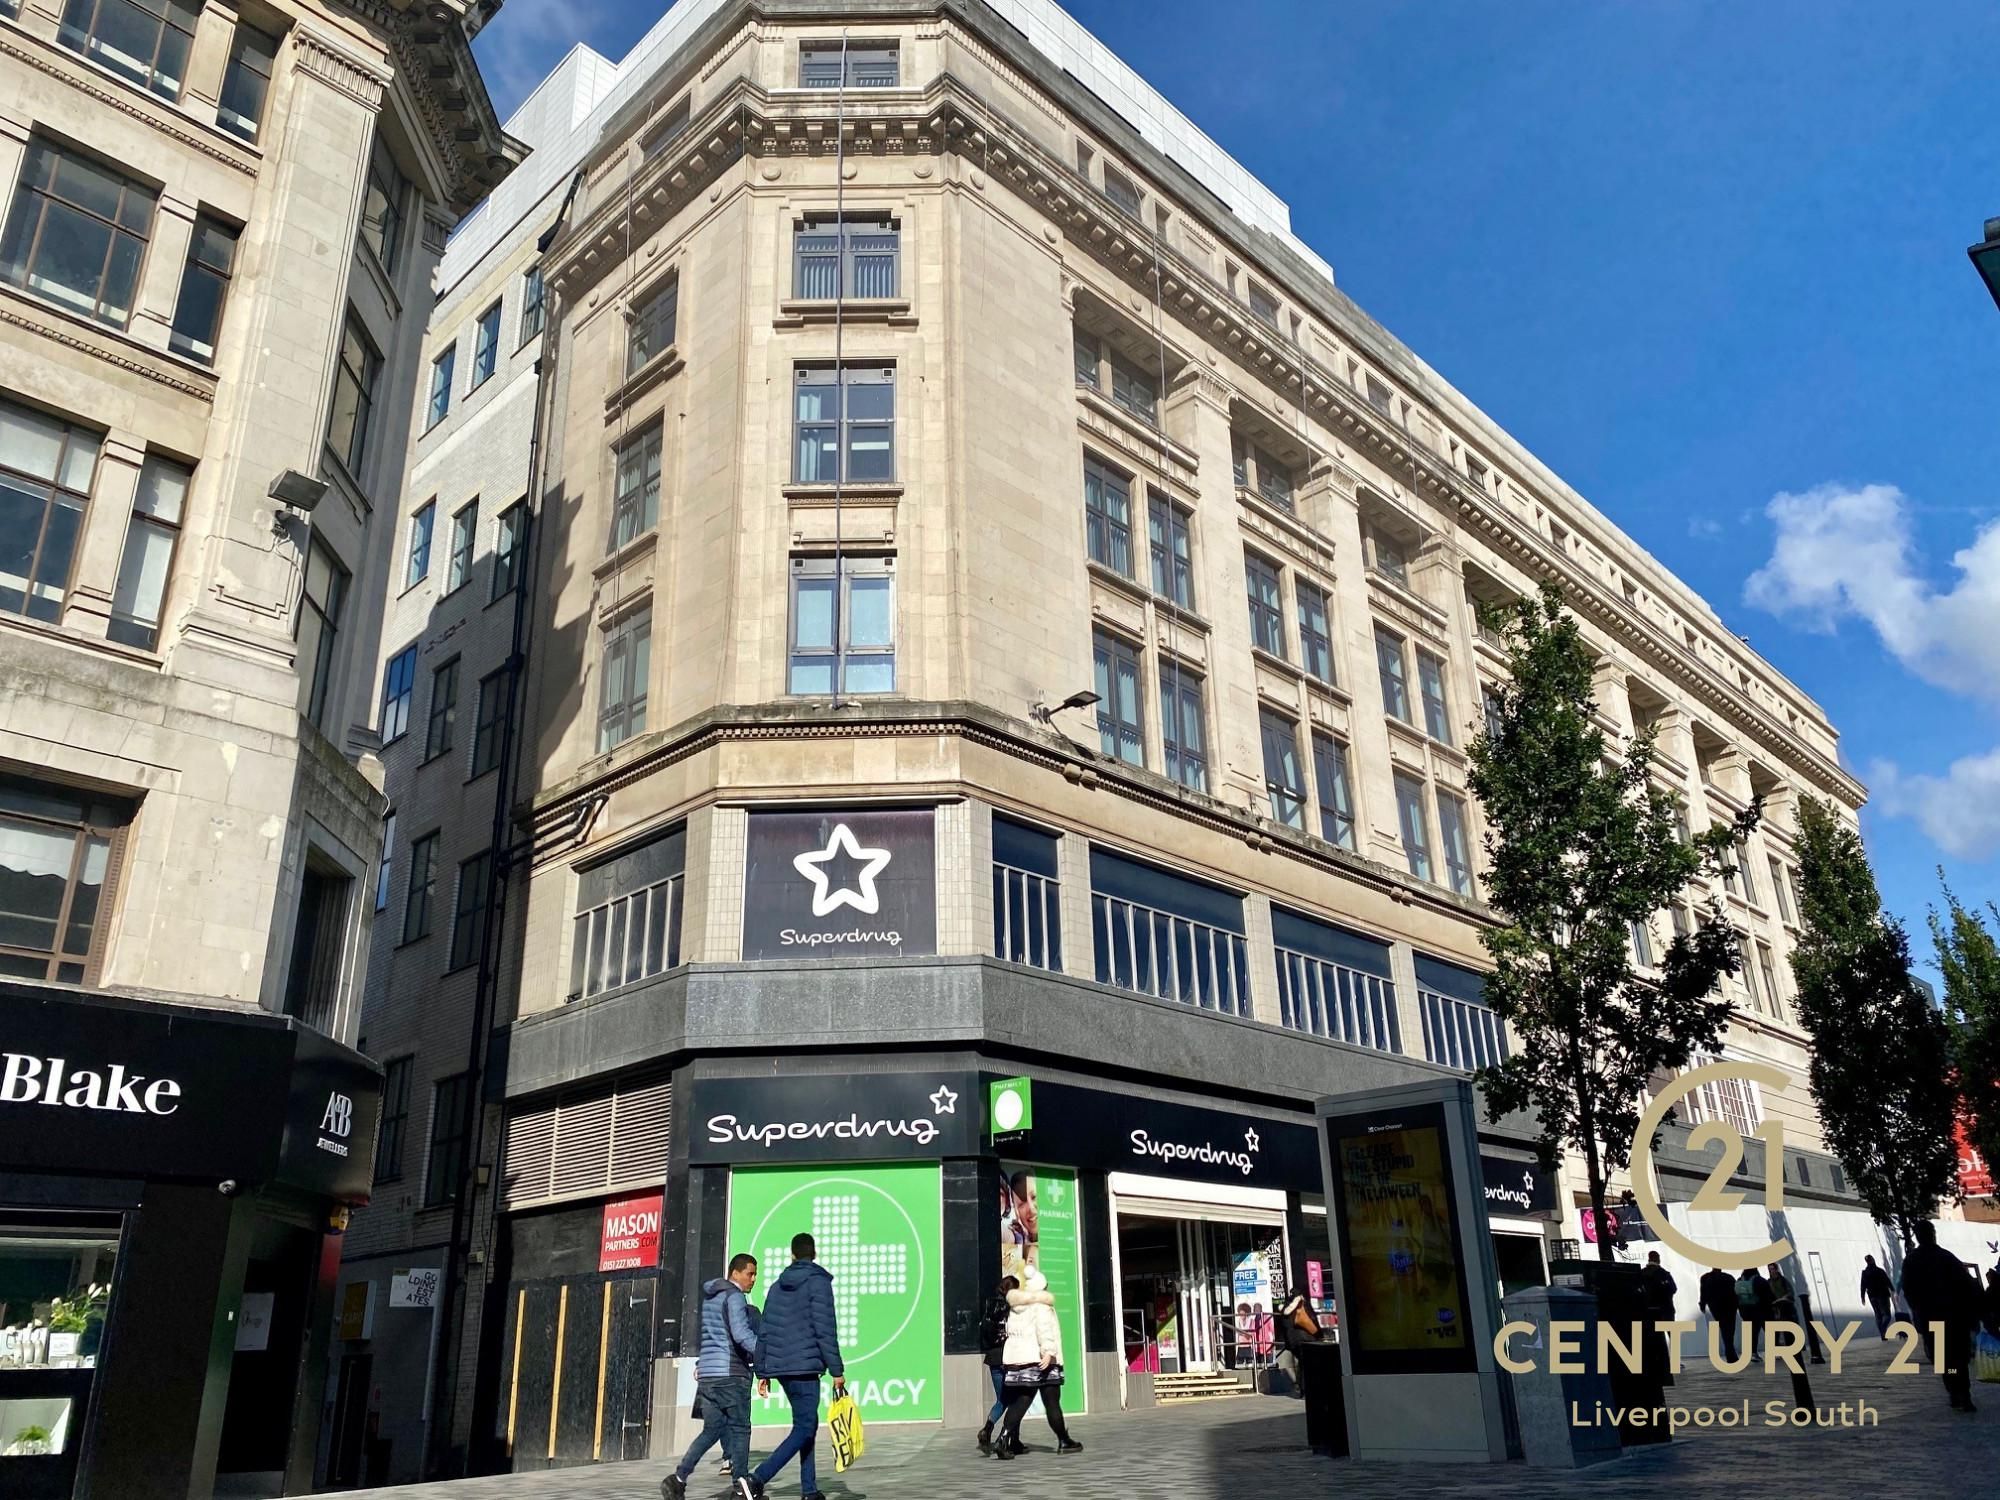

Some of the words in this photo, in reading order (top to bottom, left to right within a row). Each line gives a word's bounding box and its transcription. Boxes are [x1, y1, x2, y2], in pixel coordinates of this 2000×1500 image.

[779, 927, 903, 947] Superdrug
[0, 1053, 182, 1115] Blake
[707, 1113, 940, 1147] Superdrug
[1130, 1129, 1254, 1176] Superdrug
[1484, 1184, 1532, 1209] erdrug
[1039, 1209, 1073, 1220] PHARMACY
[606, 1211, 658, 1238] MASON
[603, 1261, 615, 1270] 0151
[615, 1259, 626, 1269] 227
[626, 1257, 641, 1267] 1008
[408, 1275, 436, 1290] LDING
[425, 1272, 437, 1282] GO
[406, 1293, 430, 1306] ATES
[417, 1286, 434, 1298] EST
